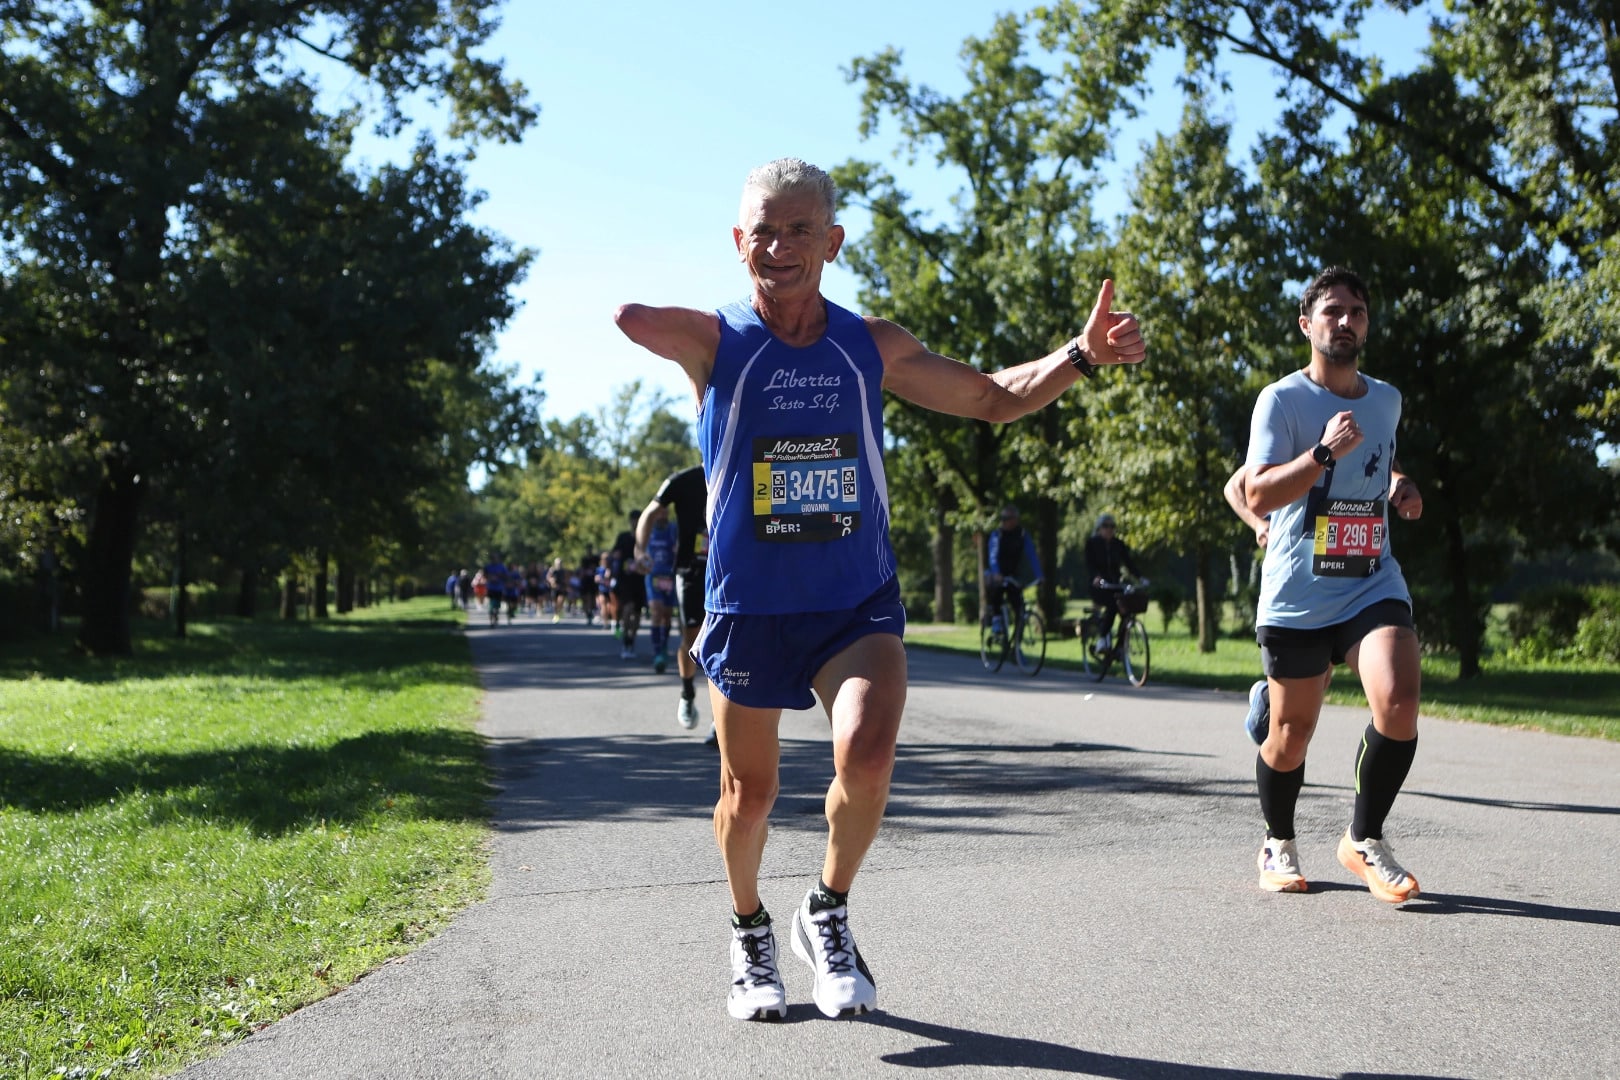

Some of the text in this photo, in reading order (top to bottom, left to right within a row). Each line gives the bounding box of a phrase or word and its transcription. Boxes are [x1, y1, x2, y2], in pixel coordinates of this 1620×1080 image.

[763, 368, 841, 391] Libertas
[768, 393, 840, 413] Sesto S.G.
[772, 437, 839, 453] Monza21
[757, 469, 838, 501] 2 3475
[801, 503, 829, 513] GIOVANNI
[1343, 524, 1367, 546] 296
